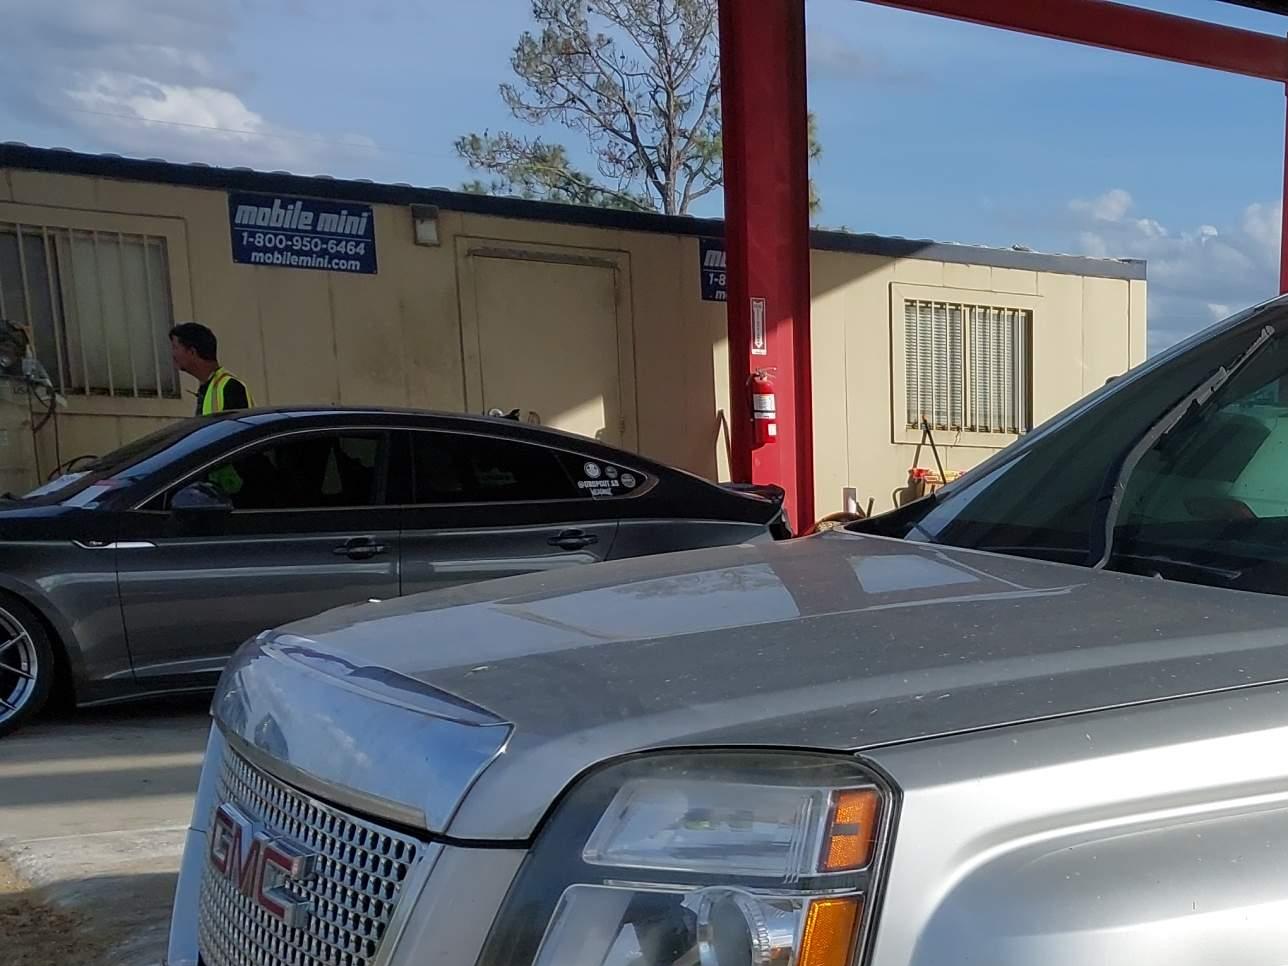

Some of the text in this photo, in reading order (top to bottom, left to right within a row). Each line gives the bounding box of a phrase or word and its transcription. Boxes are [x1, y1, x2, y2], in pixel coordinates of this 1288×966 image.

[235, 199, 369, 235] mobile mini
[242, 232, 366, 255] 1-800-950-6464
[251, 252, 361, 270] mobilemini.com
[210, 803, 312, 924] GMC
